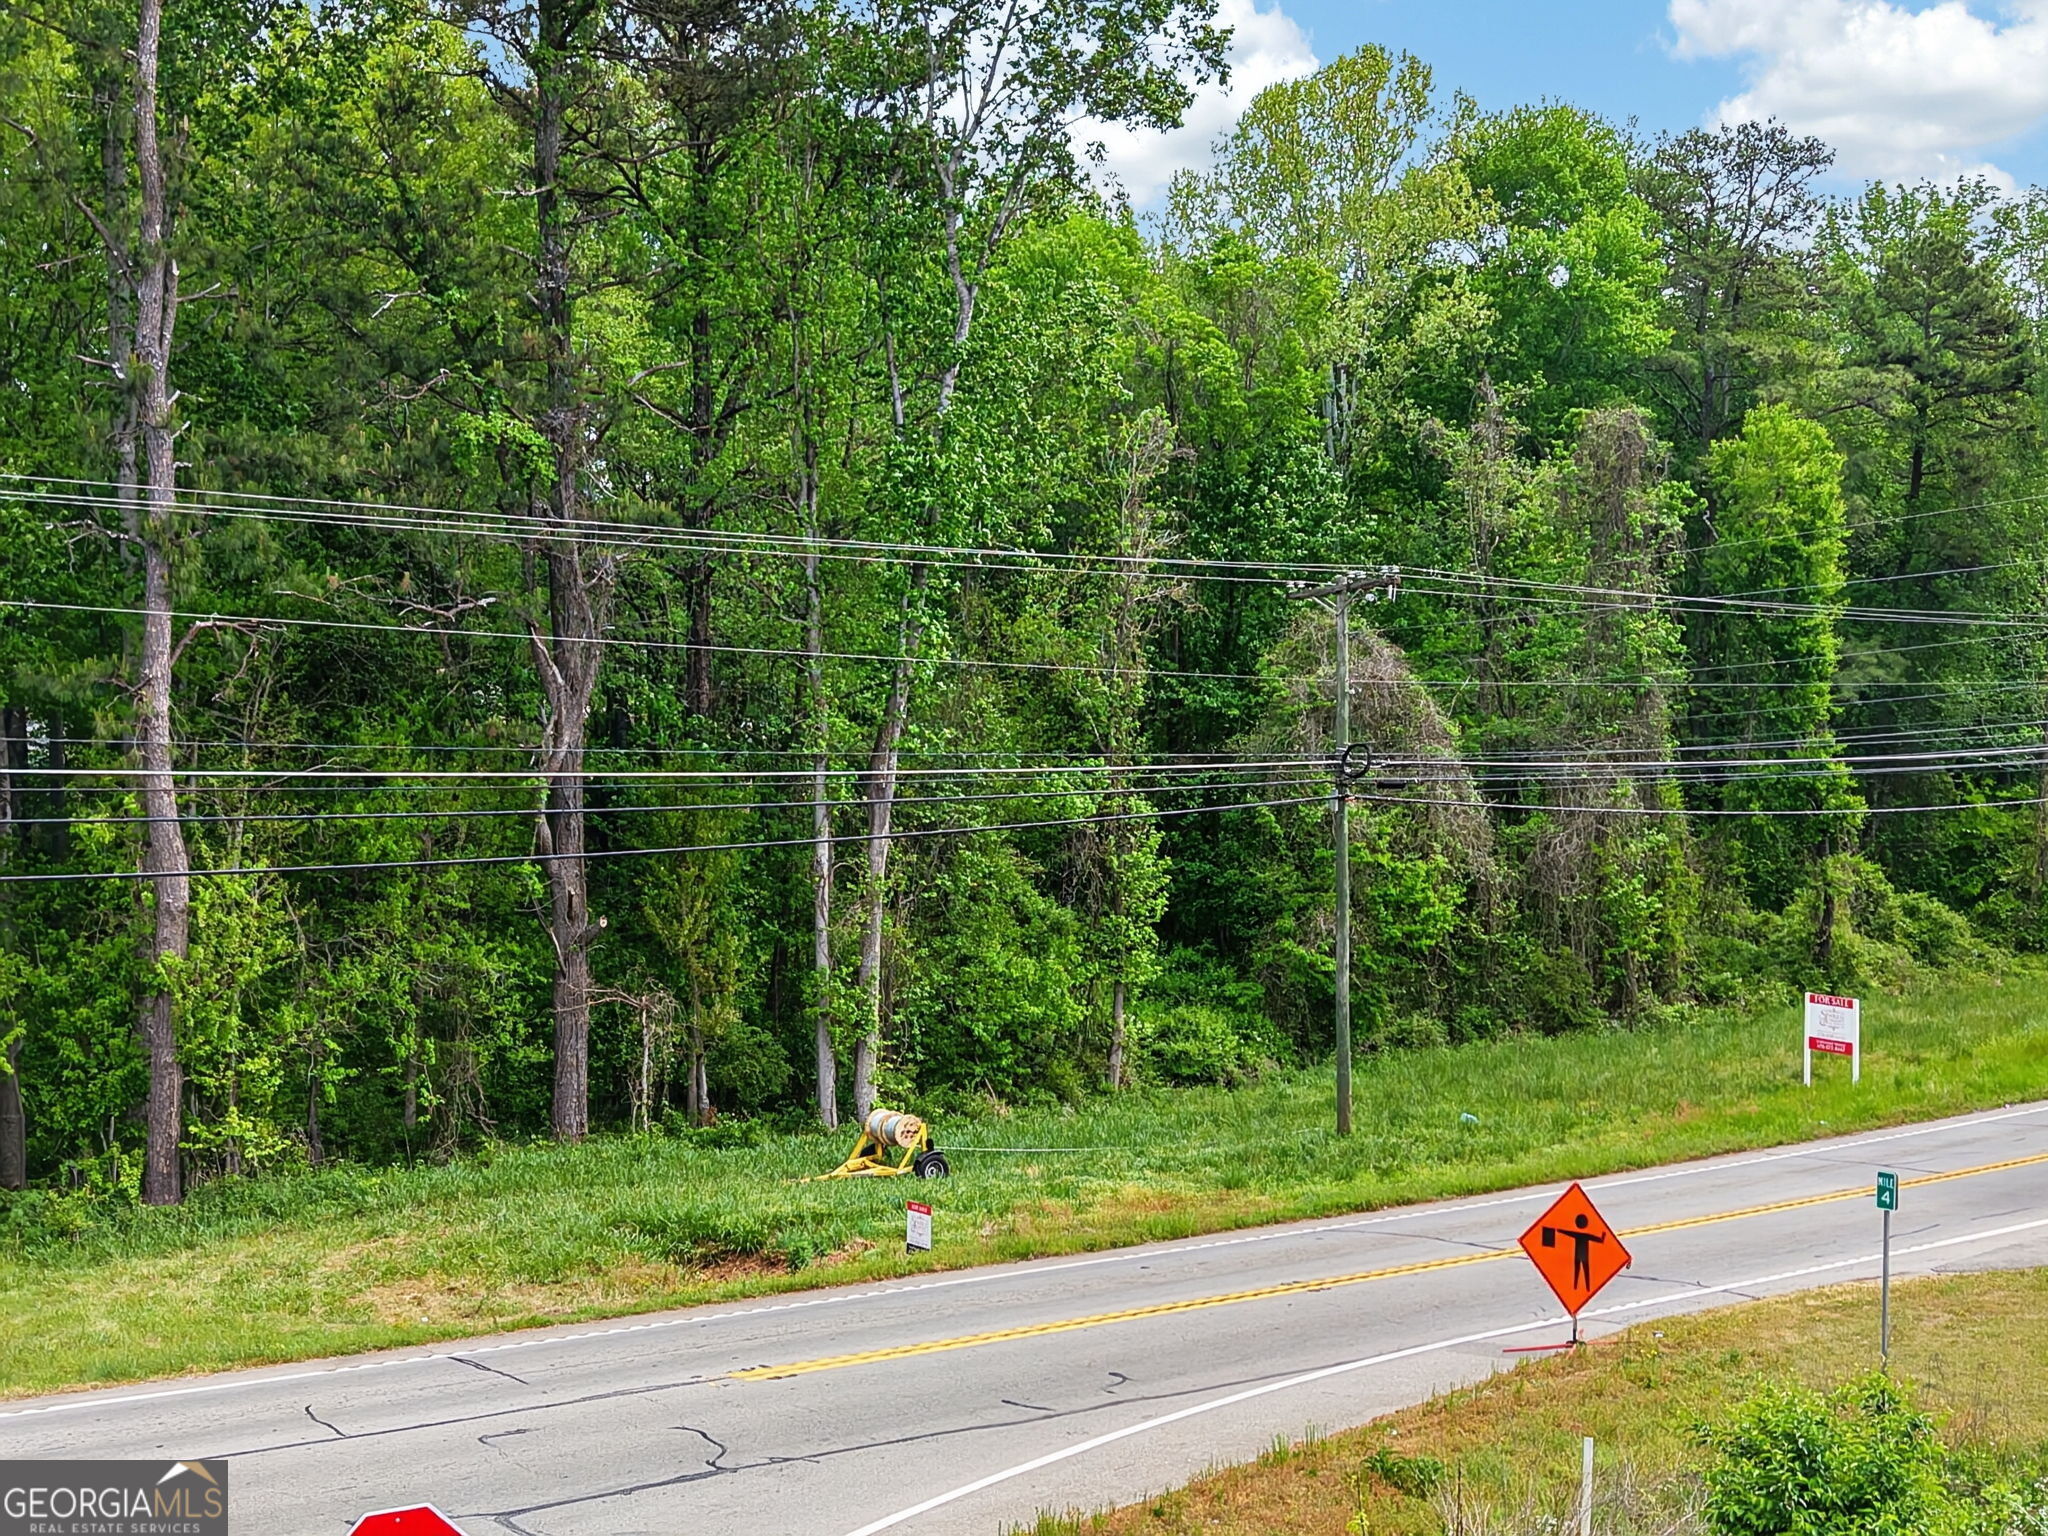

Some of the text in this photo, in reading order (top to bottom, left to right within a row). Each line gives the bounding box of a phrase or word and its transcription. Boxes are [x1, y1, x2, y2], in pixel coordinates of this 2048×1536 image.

[1814, 994, 1849, 1007] FOR SALE
[1878, 1176, 1893, 1189] MILE
[1881, 1190, 1890, 1205] 4
